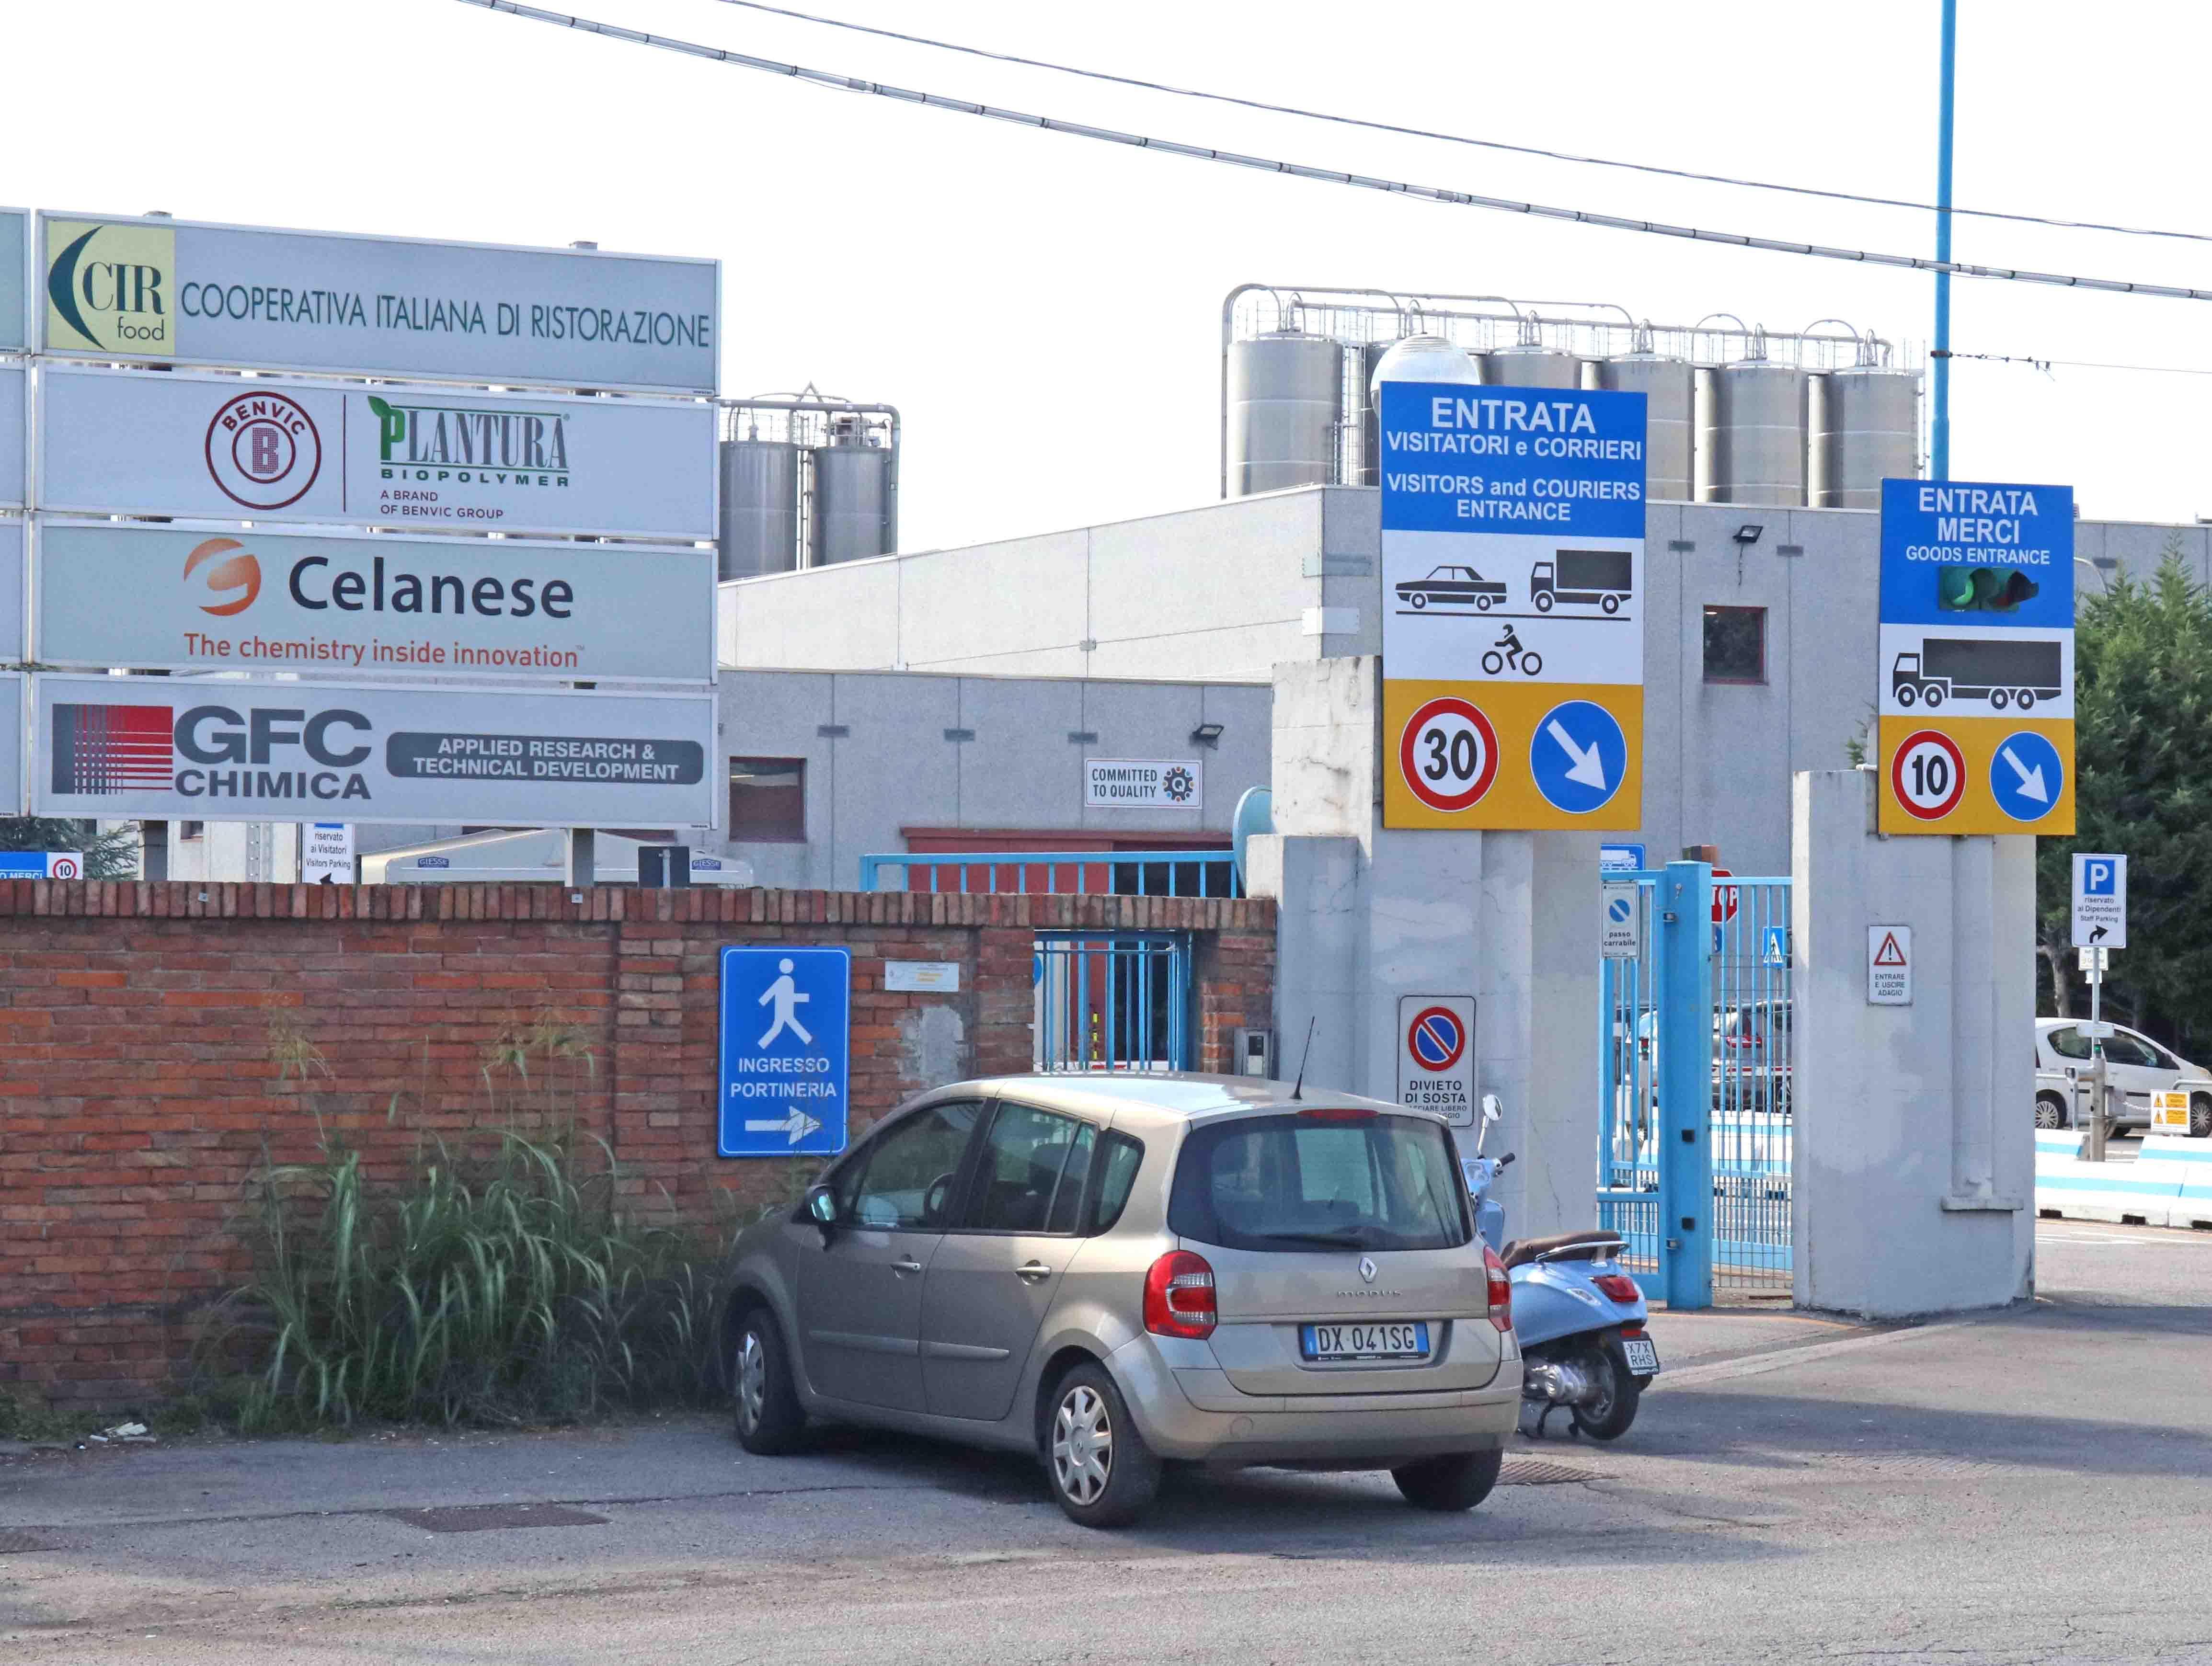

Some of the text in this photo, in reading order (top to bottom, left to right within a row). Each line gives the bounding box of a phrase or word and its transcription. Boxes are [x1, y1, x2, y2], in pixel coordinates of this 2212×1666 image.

[82, 262, 165, 315] CIR
[182, 282, 709, 348] COOPERATIVA ITALIANA DI RISTORAZIONE
[117, 316, 164, 341] food
[221, 401, 306, 436] BENVIC
[1432, 397, 1596, 434] ENTRATA
[367, 396, 569, 469] PLANTURA
[252, 427, 278, 473] B
[1387, 431, 1641, 460] VISITATORI e CORRIERI
[381, 468, 569, 487] BIOPOLYMER
[1387, 473, 1640, 501] VISITORS and COURIERS
[381, 491, 438, 502] A BRAND
[1919, 487, 2038, 516] ENTRATA
[381, 505, 504, 520] OF BENVIC GROUP
[1457, 499, 1570, 521] ENTRANCE
[1937, 517, 2019, 544] MERCI
[1906, 546, 2051, 565] GOODS ENTRANCE
[289, 556, 573, 618] Celanese
[184, 633, 578, 668] The chemistry inside innovation
[173, 705, 372, 768] GFC
[437, 738, 655, 760] APPLIED RESEARCH &
[1423, 728, 1478, 781] 30
[413, 758, 679, 781] TECHNICAL DEVELOPMENT
[1092, 768, 1157, 782] COMMITTED
[1912, 755, 1948, 796] 10
[175, 769, 372, 800] CHIMICA
[1093, 785, 1157, 798] TO QUALITY
[314, 832, 344, 842] riservato
[318, 845, 346, 854] Visitatori
[59, 865, 71, 876] 10
[306, 858, 351, 870] Visitors Parking
[2090, 864, 2109, 890] P
[1711, 887, 1739, 906] TOP
[738, 1058, 830, 1073] INGRESSO
[731, 1082, 837, 1098] PORTINERIA
[1410, 1081, 1462, 1090] DIVIETO
[1405, 1094, 1466, 1103] DI SOSTA
[1318, 1327, 1345, 1351] DX
[1352, 1326, 1414, 1350] 041SG
[1630, 1355, 1652, 1365] RHS
